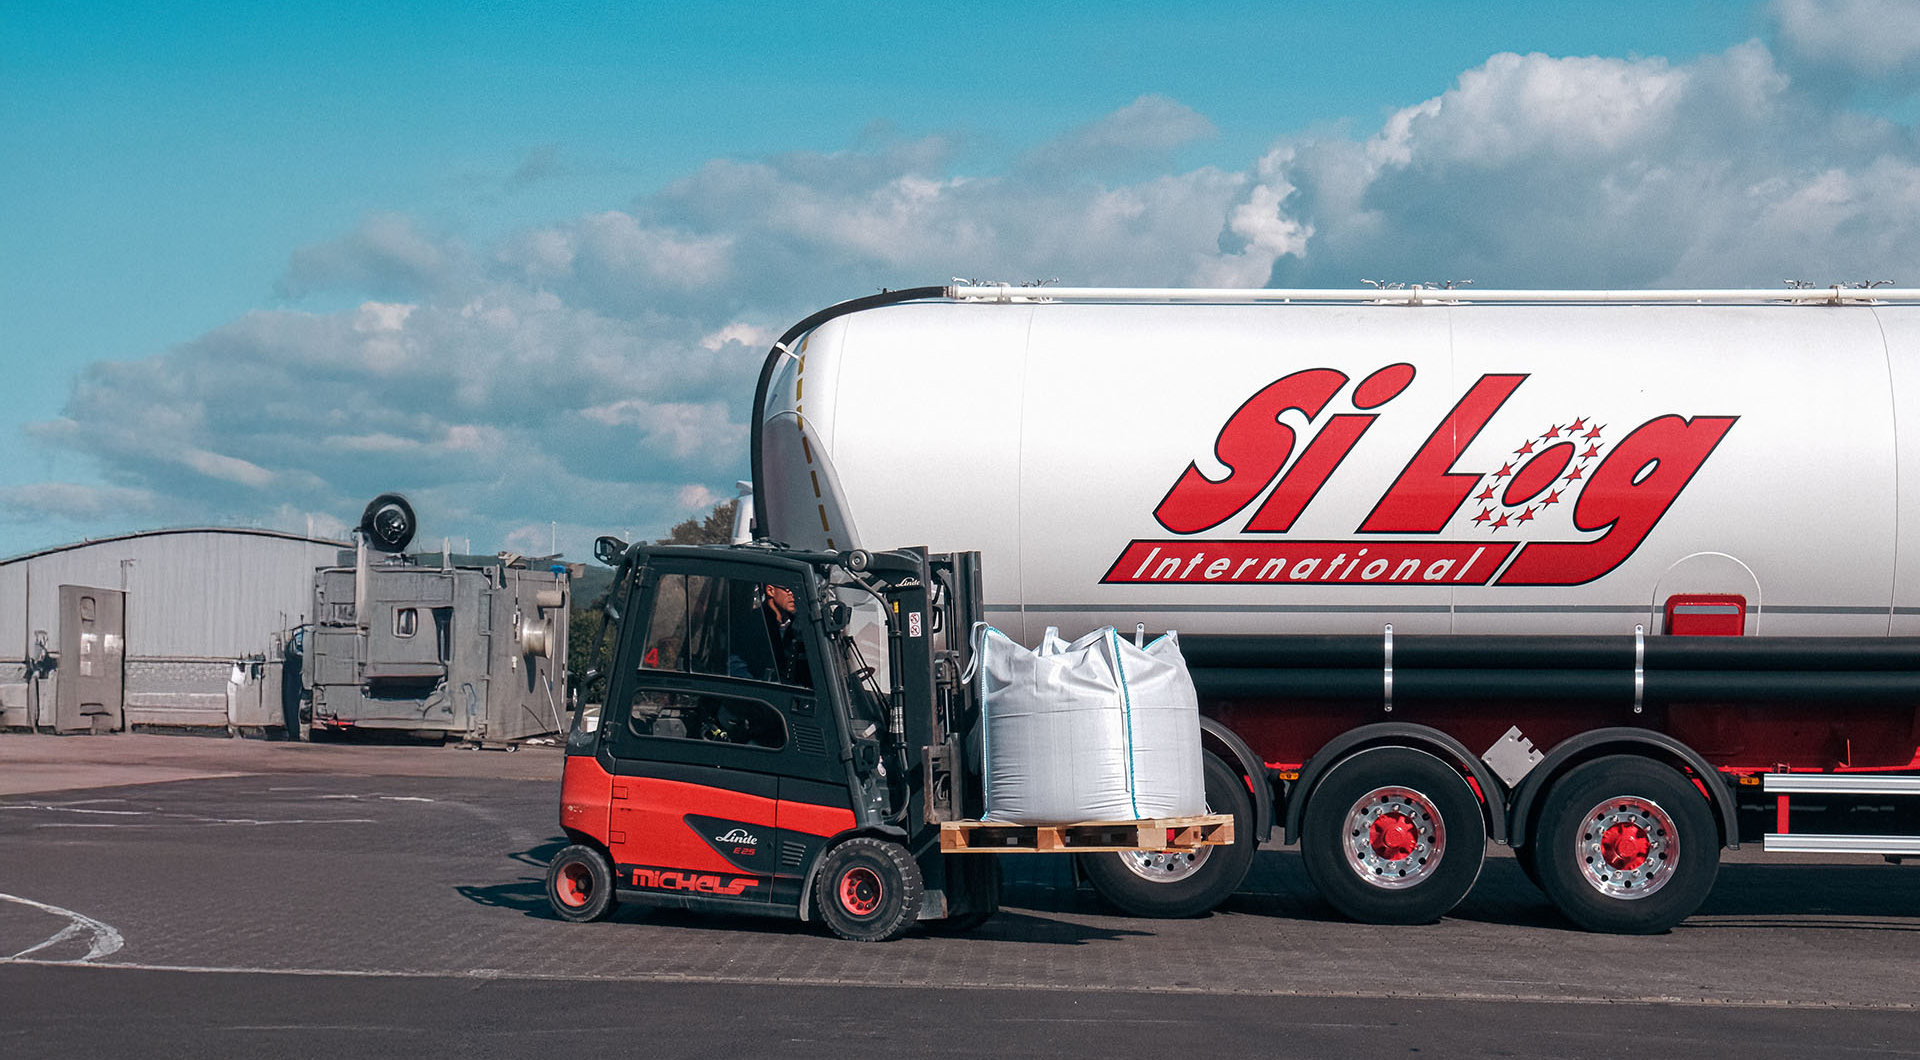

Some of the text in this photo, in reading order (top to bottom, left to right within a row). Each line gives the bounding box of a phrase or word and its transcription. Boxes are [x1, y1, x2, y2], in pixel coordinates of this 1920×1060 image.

[1152, 362, 1741, 587] Si Log
[1131, 546, 1486, 581] International
[644, 647, 659, 668] 4
[715, 828, 758, 845] Linde
